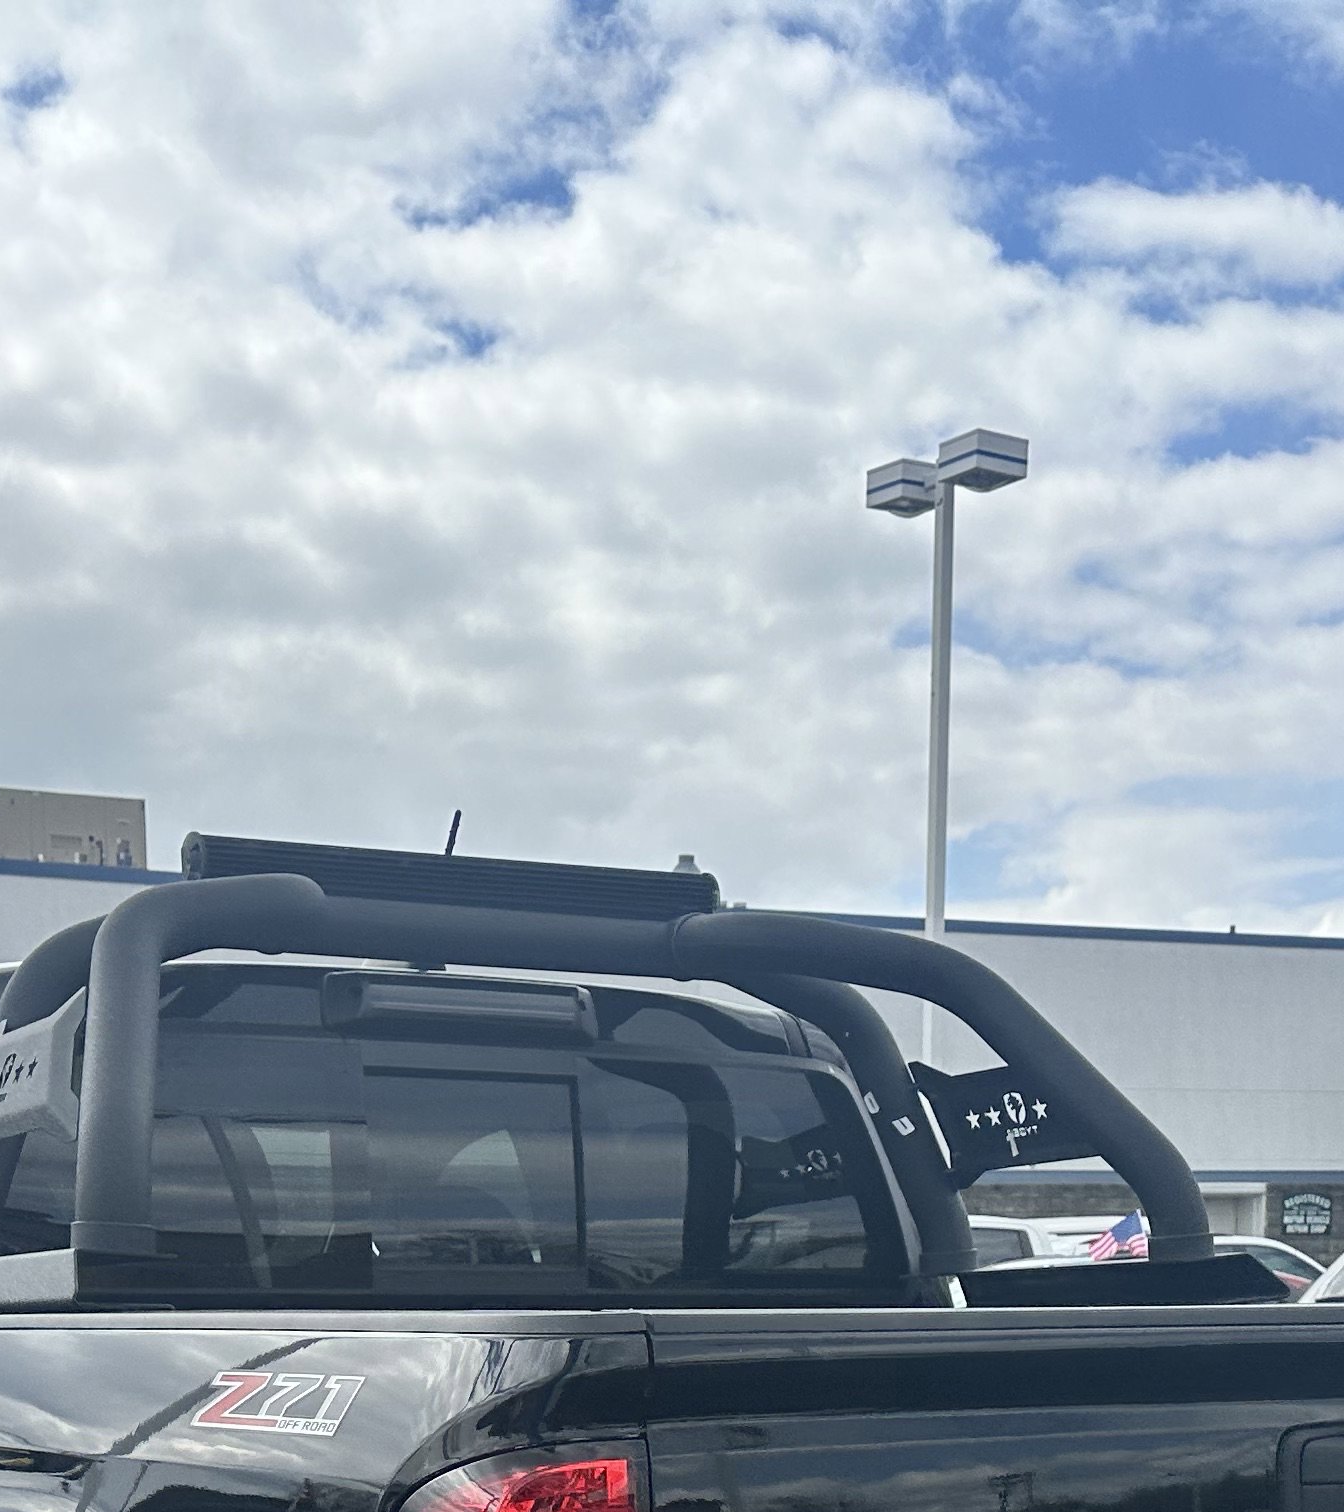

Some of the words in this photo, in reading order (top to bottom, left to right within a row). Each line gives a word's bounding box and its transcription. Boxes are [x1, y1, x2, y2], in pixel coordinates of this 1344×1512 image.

[190, 1370, 367, 1434] Z71
[277, 1419, 300, 1431] OFF
[300, 1421, 337, 1433] ROAD
